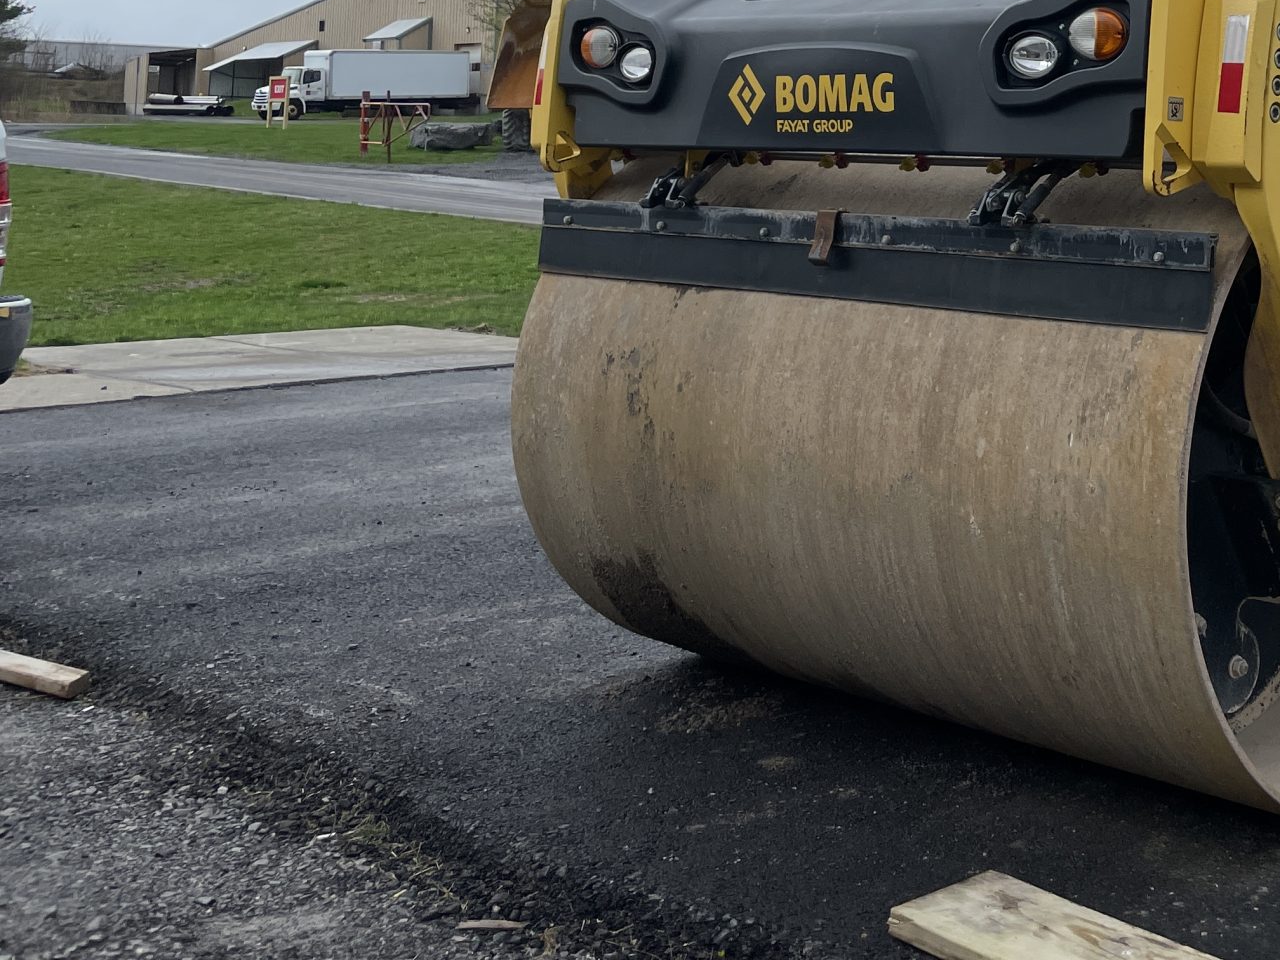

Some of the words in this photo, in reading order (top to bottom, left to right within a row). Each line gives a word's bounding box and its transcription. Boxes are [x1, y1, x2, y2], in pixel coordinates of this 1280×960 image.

[775, 73, 895, 113] BOMAG
[776, 120, 809, 132] FAYAT
[813, 120, 853, 132] GROUP
